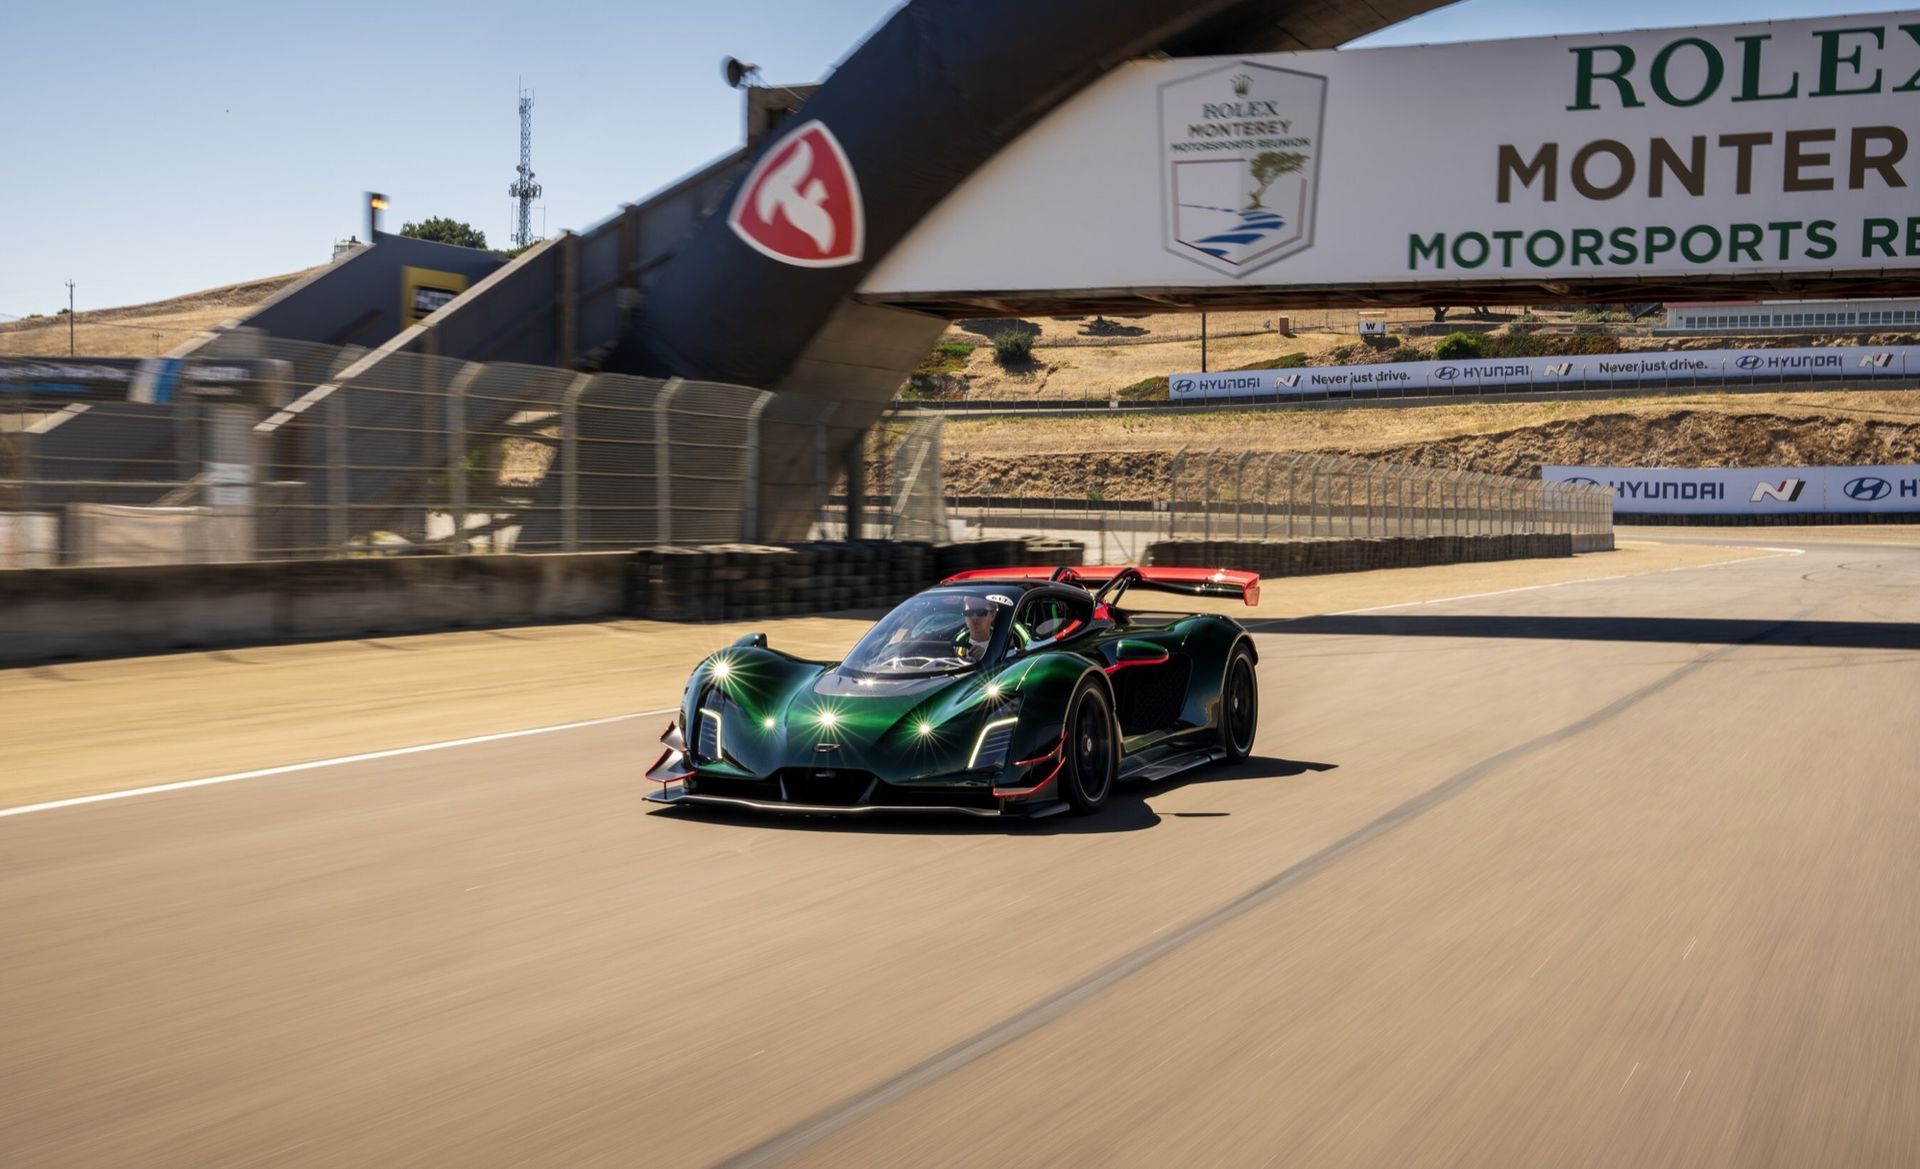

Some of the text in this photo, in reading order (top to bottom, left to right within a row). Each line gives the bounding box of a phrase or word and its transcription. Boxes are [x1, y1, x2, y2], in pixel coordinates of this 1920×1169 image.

[1202, 101, 1279, 119] ROLEX
[1186, 120, 1292, 138] MONTEREY
[1497, 126, 1908, 203] MONTER
[1408, 219, 1837, 270] MOTORSPORTS
[1200, 377, 1260, 390] HYUNDAI
[1311, 374, 1347, 385] Never
[1350, 371, 1373, 384] just
[1375, 370, 1410, 381] drive.
[1464, 365, 1529, 378] HYUNDAI
[1599, 361, 1638, 373] Never
[1641, 360, 1667, 373] just
[1669, 358, 1708, 371] drive.
[1768, 355, 1842, 368] HYUNDAI
[1609, 480, 1724, 499] HYUNDAI
